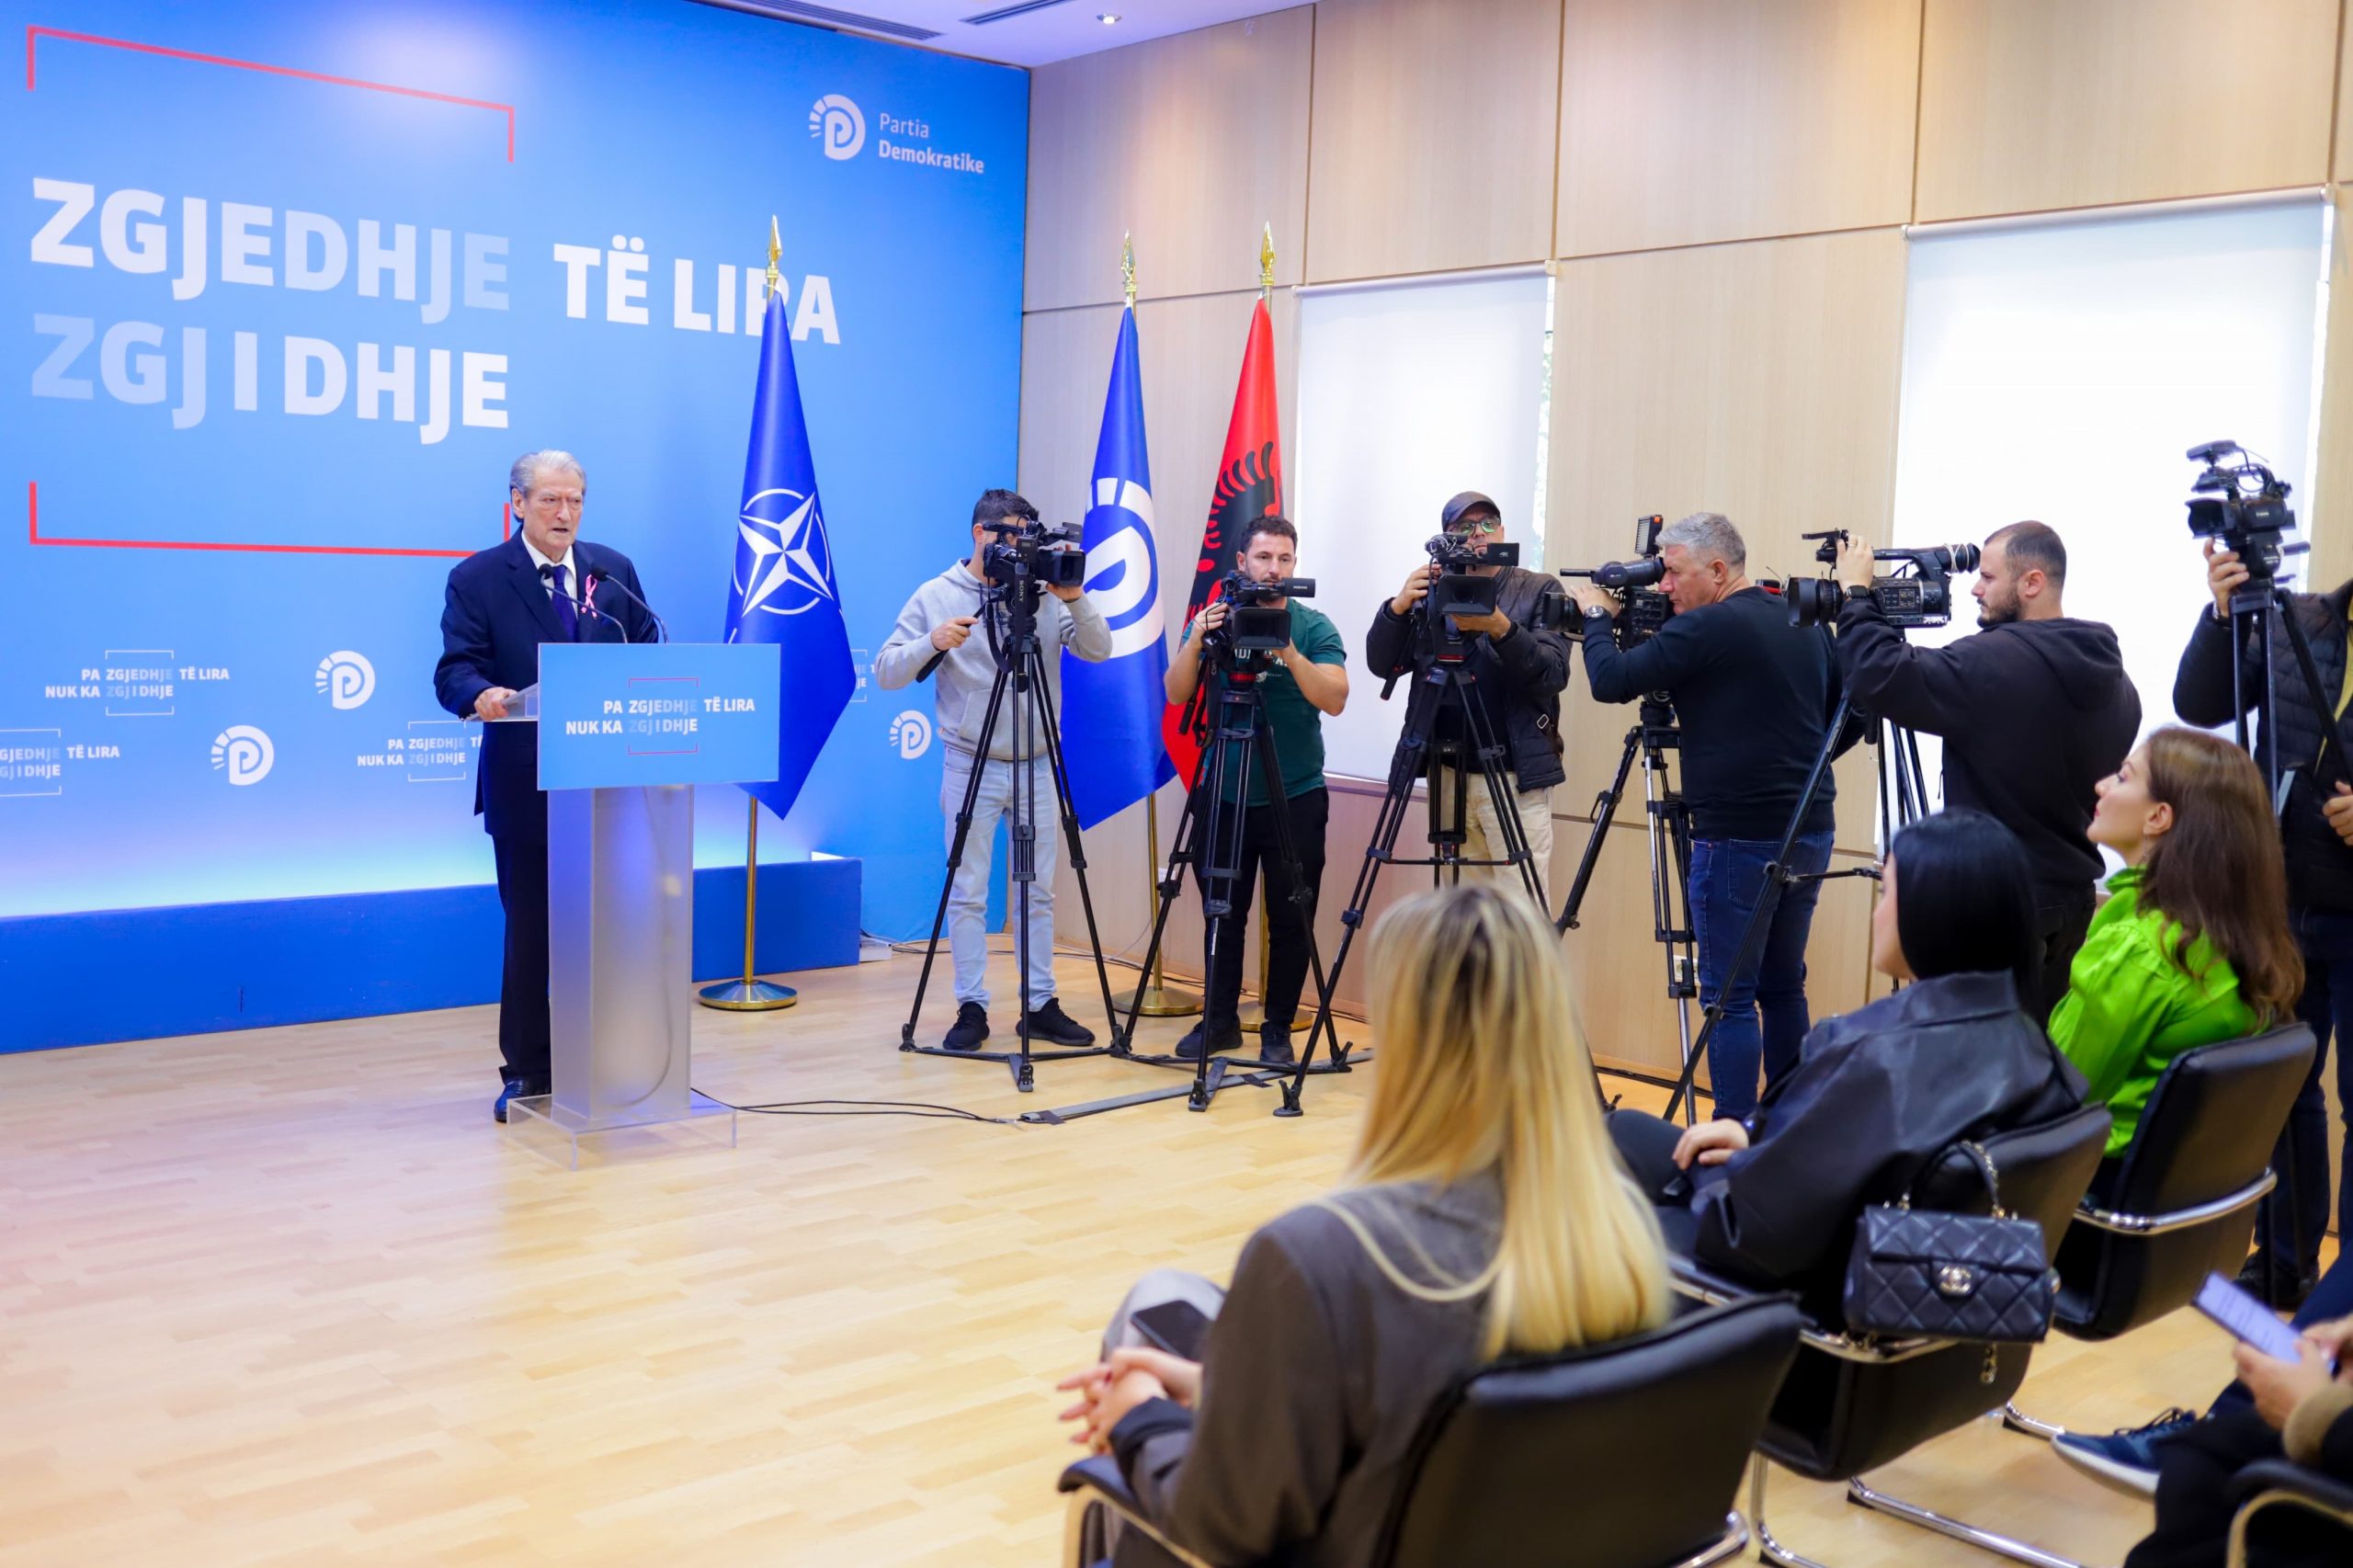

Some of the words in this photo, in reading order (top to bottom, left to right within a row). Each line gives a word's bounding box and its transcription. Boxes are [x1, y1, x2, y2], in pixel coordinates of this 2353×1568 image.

[880, 112, 929, 139] Partia
[878, 140, 985, 174] Demokratike
[30, 177, 509, 324] ZGJEDHJE
[553, 234, 649, 325] TË
[81, 669, 100, 681] PA
[106, 669, 173, 683] ZGJEDHJE
[179, 666, 196, 680] TË
[199, 668, 230, 680] LIRA
[45, 686, 77, 699] NUK
[81, 686, 100, 698] KA
[603, 700, 623, 713] PA
[629, 699, 698, 716] ZGJEDHJE
[704, 696, 721, 712] TË
[723, 699, 756, 712] LIRA
[565, 721, 598, 735] NUK
[602, 721, 623, 733] KA
[388, 739, 404, 750] PA
[408, 737, 465, 751] ZGJEDHJE
[0, 747, 60, 763] GJEDHJE
[66, 744, 85, 758] TË
[87, 745, 120, 758] LIRA
[357, 756, 384, 767] NUK
[387, 755, 404, 765] KA
[0, 764, 61, 779] GJIDHJE
